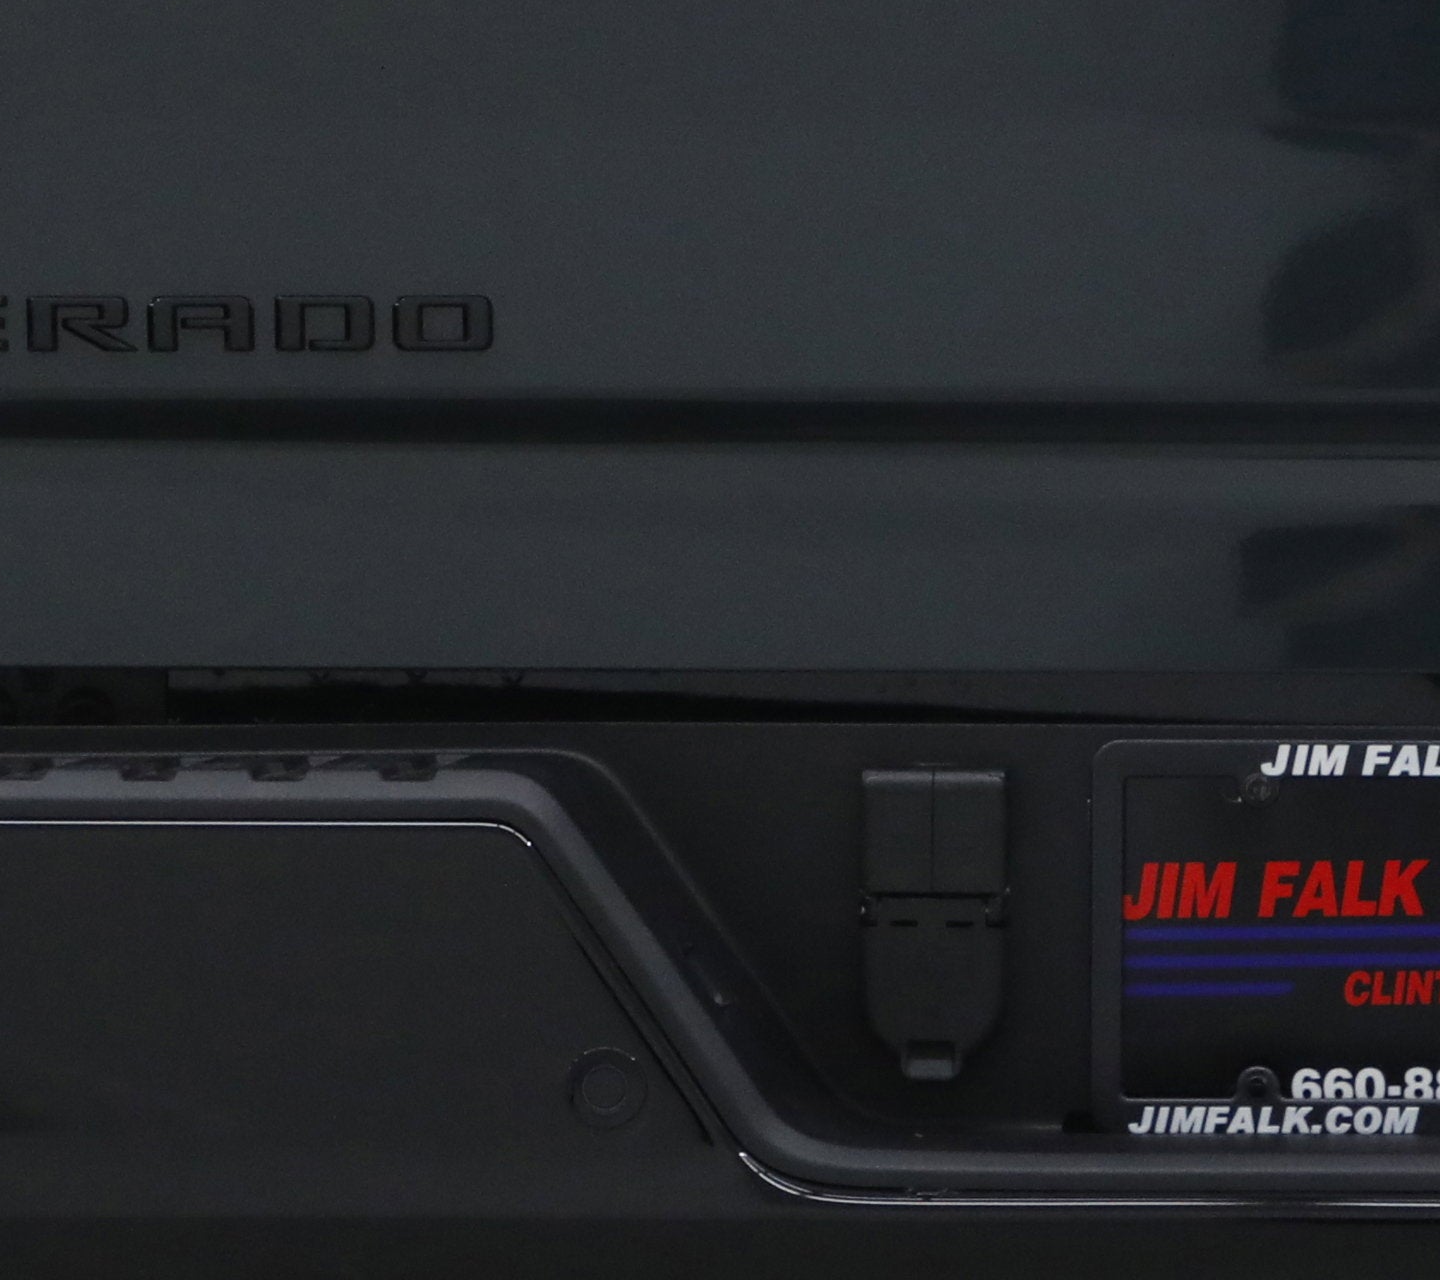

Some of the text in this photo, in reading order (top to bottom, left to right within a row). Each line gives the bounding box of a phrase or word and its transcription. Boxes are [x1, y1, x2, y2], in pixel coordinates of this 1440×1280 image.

[1260, 743, 1355, 776] JIM
[1122, 861, 1238, 921] JIM
[1257, 858, 1430, 919] FALK
[1127, 1106, 1420, 1135] JIMFALK.COM
